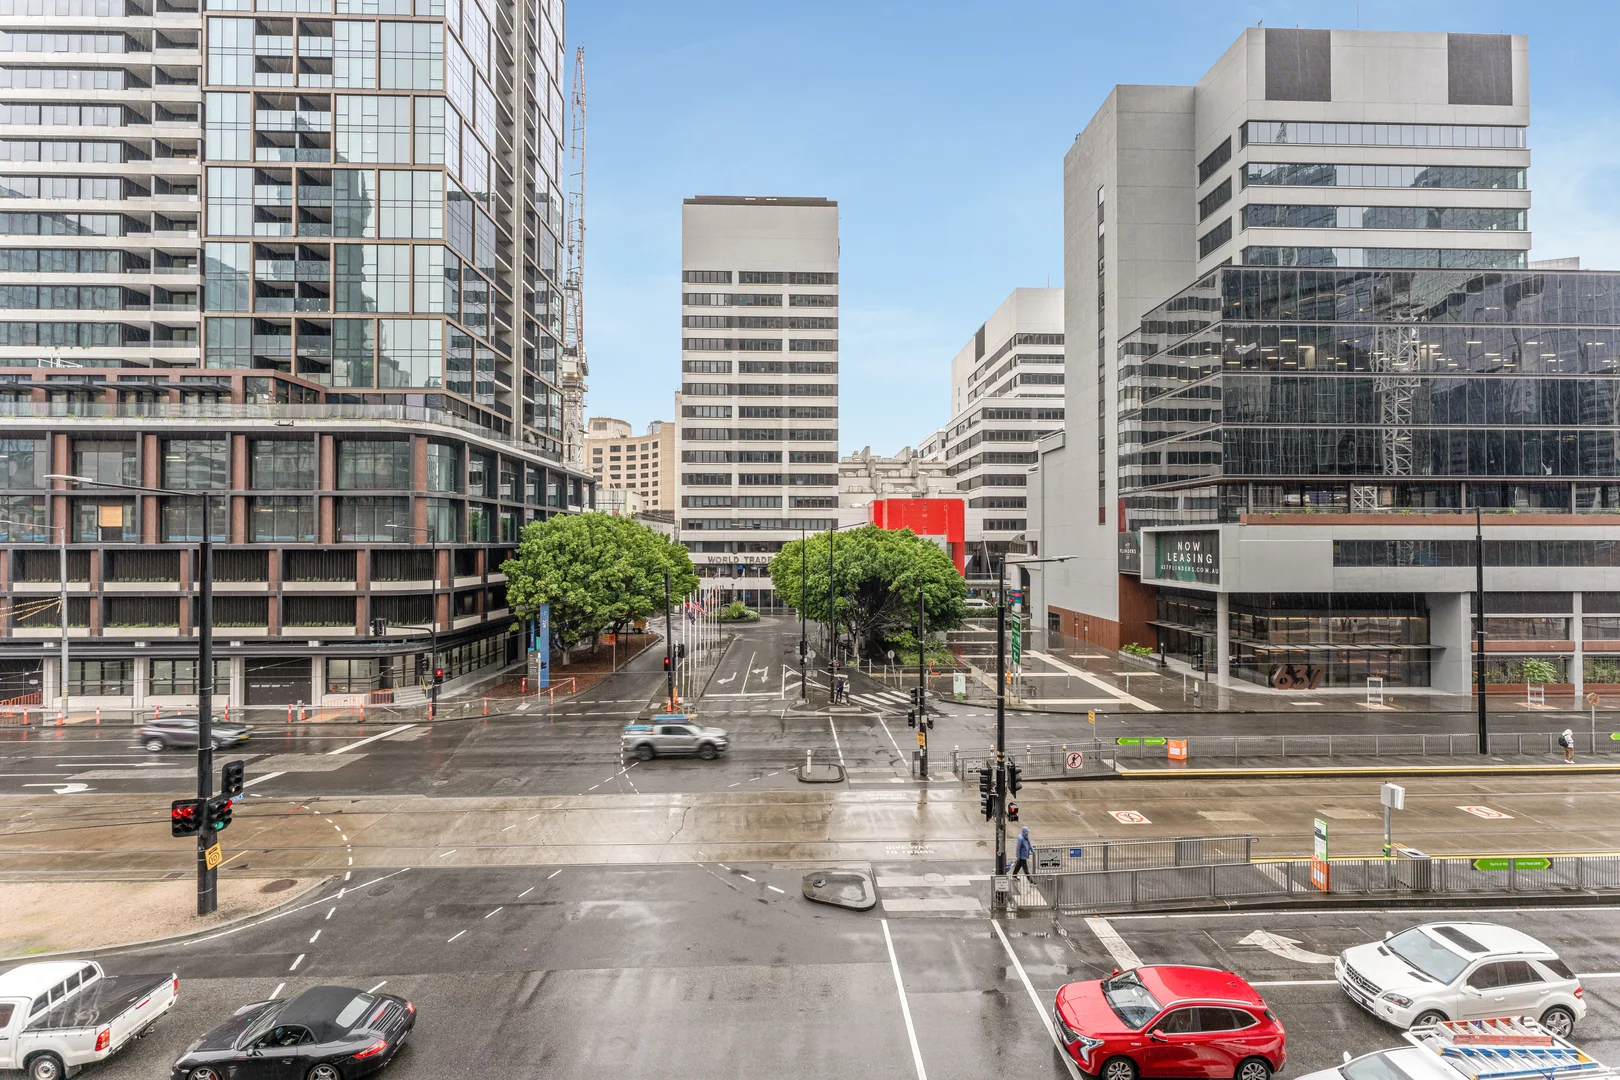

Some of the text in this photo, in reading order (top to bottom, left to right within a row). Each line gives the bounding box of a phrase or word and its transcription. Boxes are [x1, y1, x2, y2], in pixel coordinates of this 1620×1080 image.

[1177, 541, 1201, 552] NOW
[707, 555, 740, 564] WORLD
[1167, 552, 1213, 564] LEASING
[1160, 564, 1219, 575] 637FLINDERS.COM.AU
[1270, 664, 1326, 690] 637
